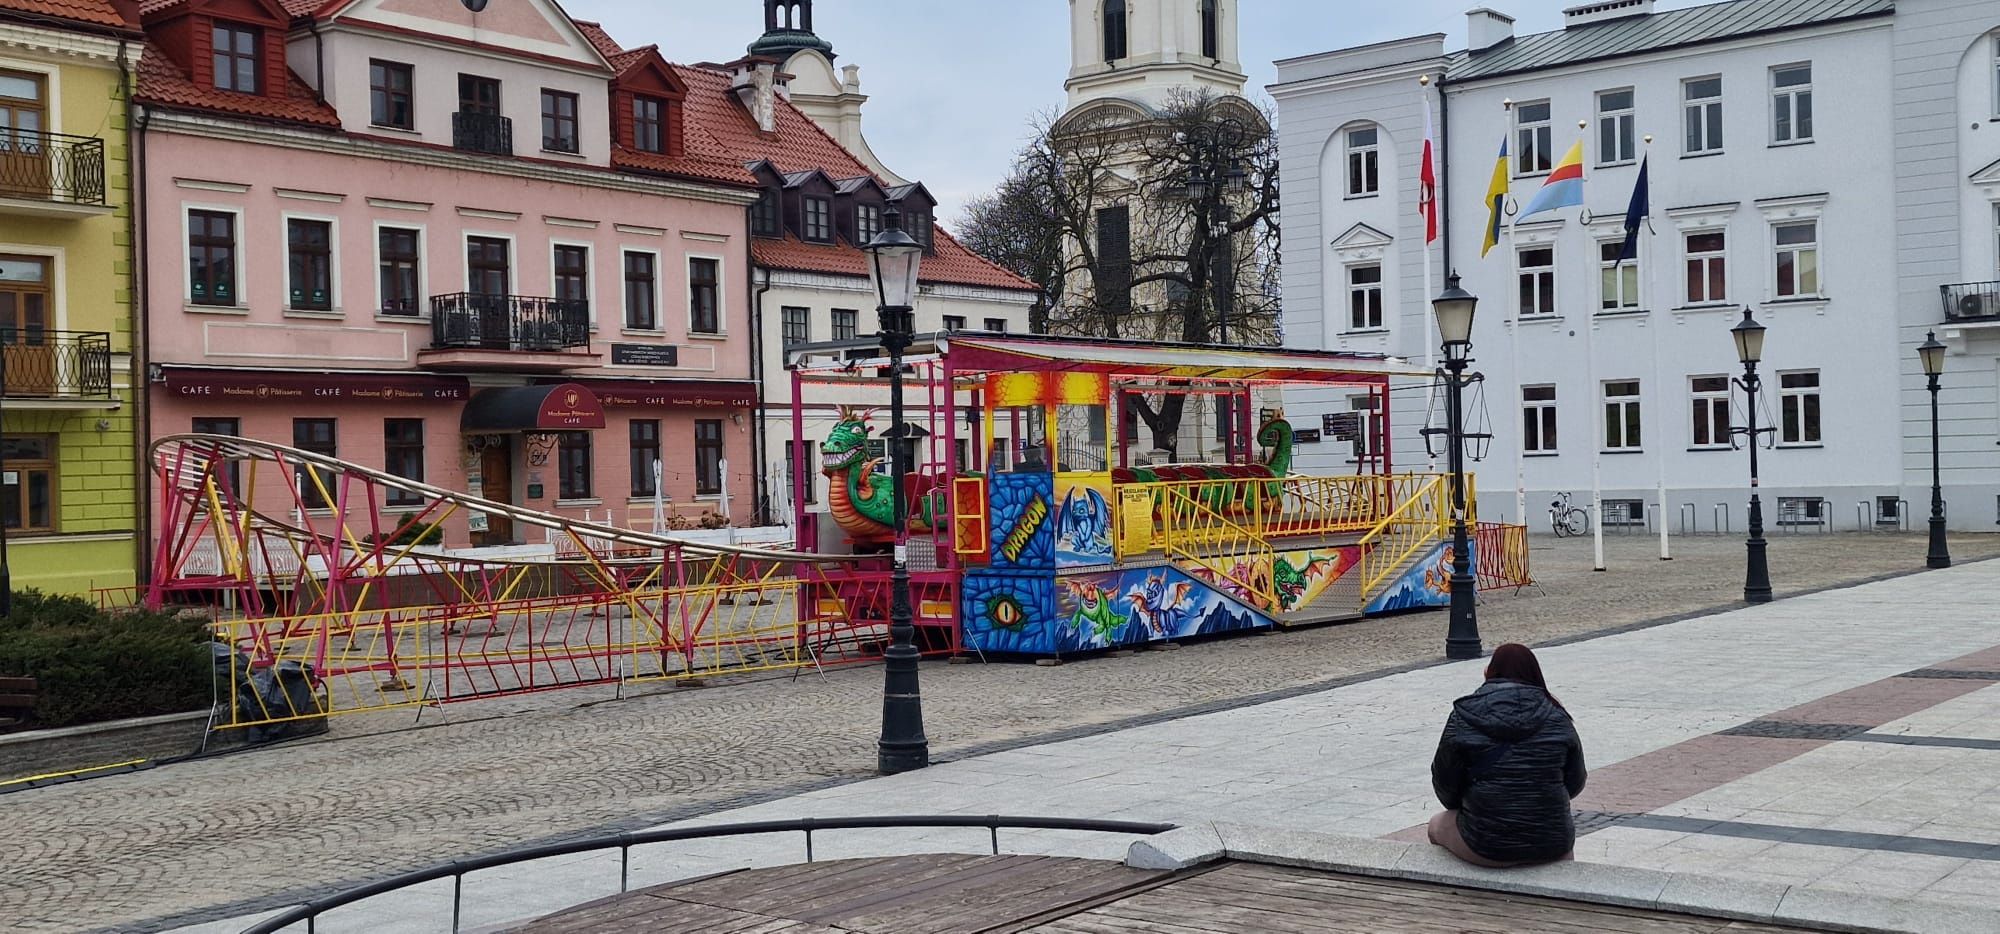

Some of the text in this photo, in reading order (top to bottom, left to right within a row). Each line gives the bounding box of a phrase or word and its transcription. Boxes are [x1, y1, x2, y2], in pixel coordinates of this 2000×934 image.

[181, 385, 211, 395] CAFÉ
[223, 387, 254, 396] Madame
[314, 387, 341, 397] CAFÉ
[352, 388, 380, 397] Madame
[434, 389, 459, 398] CAFÉ
[1003, 496, 1047, 562] DRAGON
